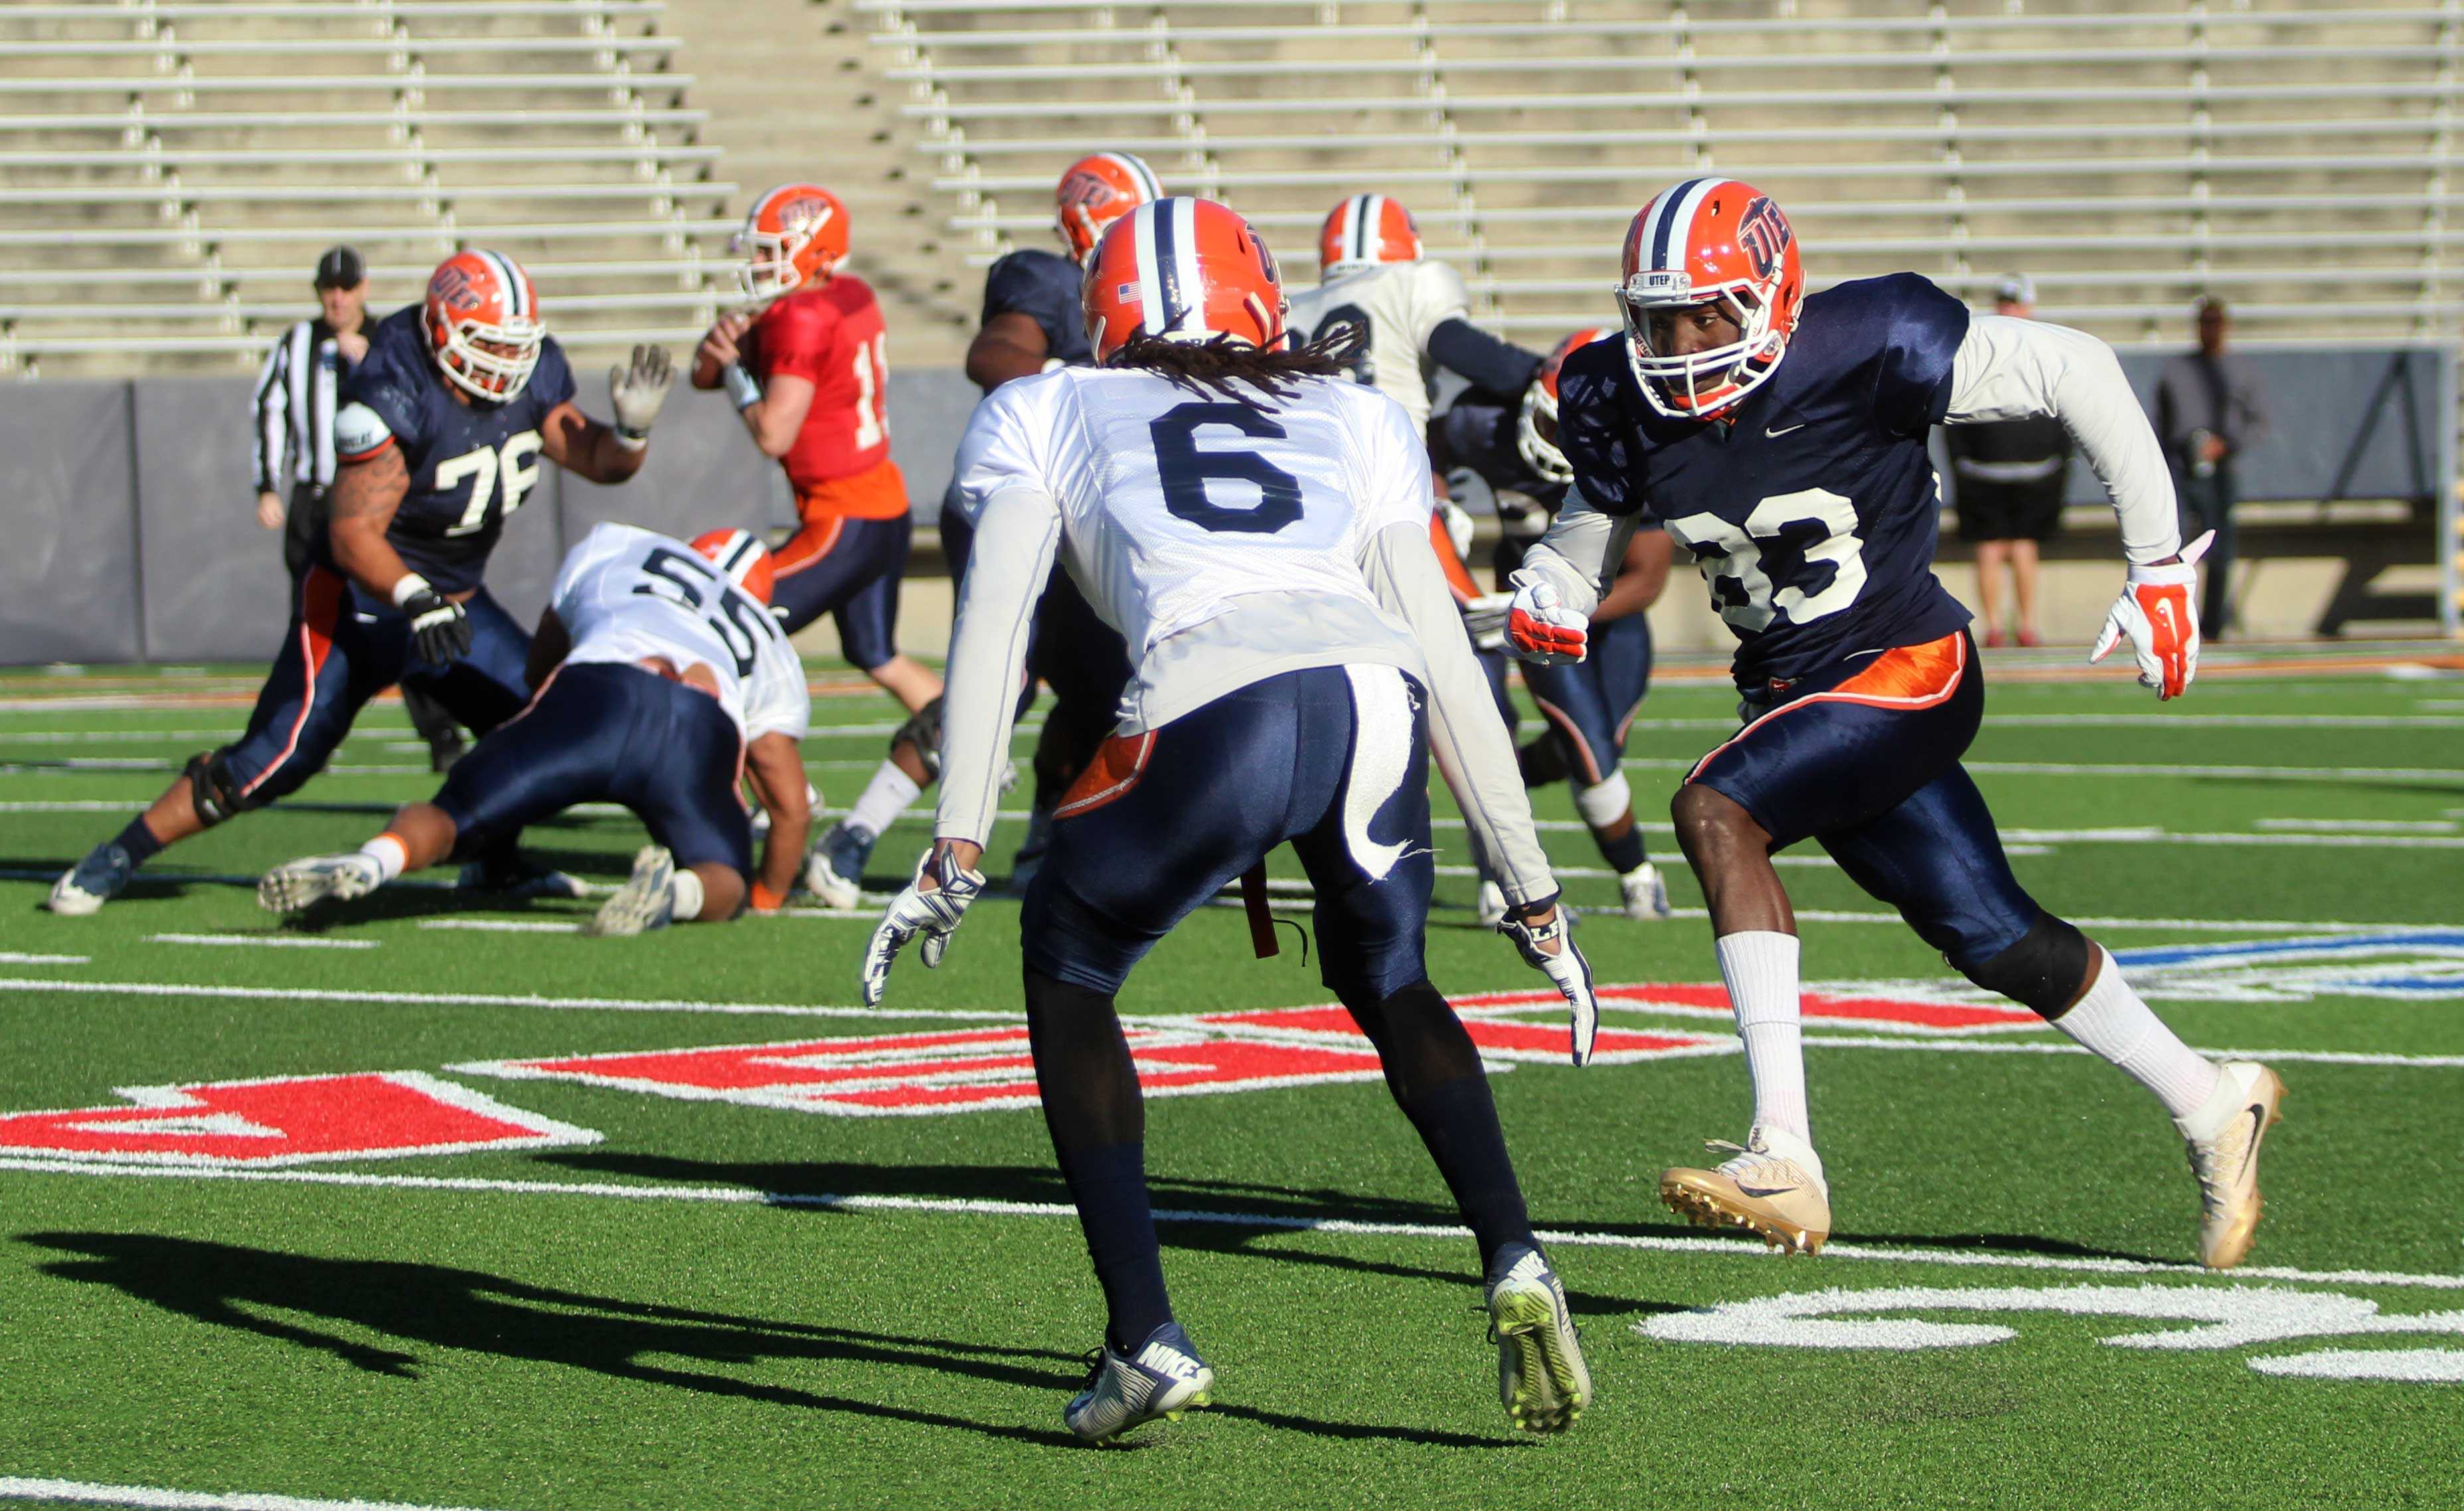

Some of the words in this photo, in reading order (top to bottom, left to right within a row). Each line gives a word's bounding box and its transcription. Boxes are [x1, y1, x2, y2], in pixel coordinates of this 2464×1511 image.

[1649, 275, 1671, 286] UTEP
[1149, 402, 1304, 534] 6
[1663, 487, 1868, 633] 83
[1136, 1341, 1200, 1382] NIKE
